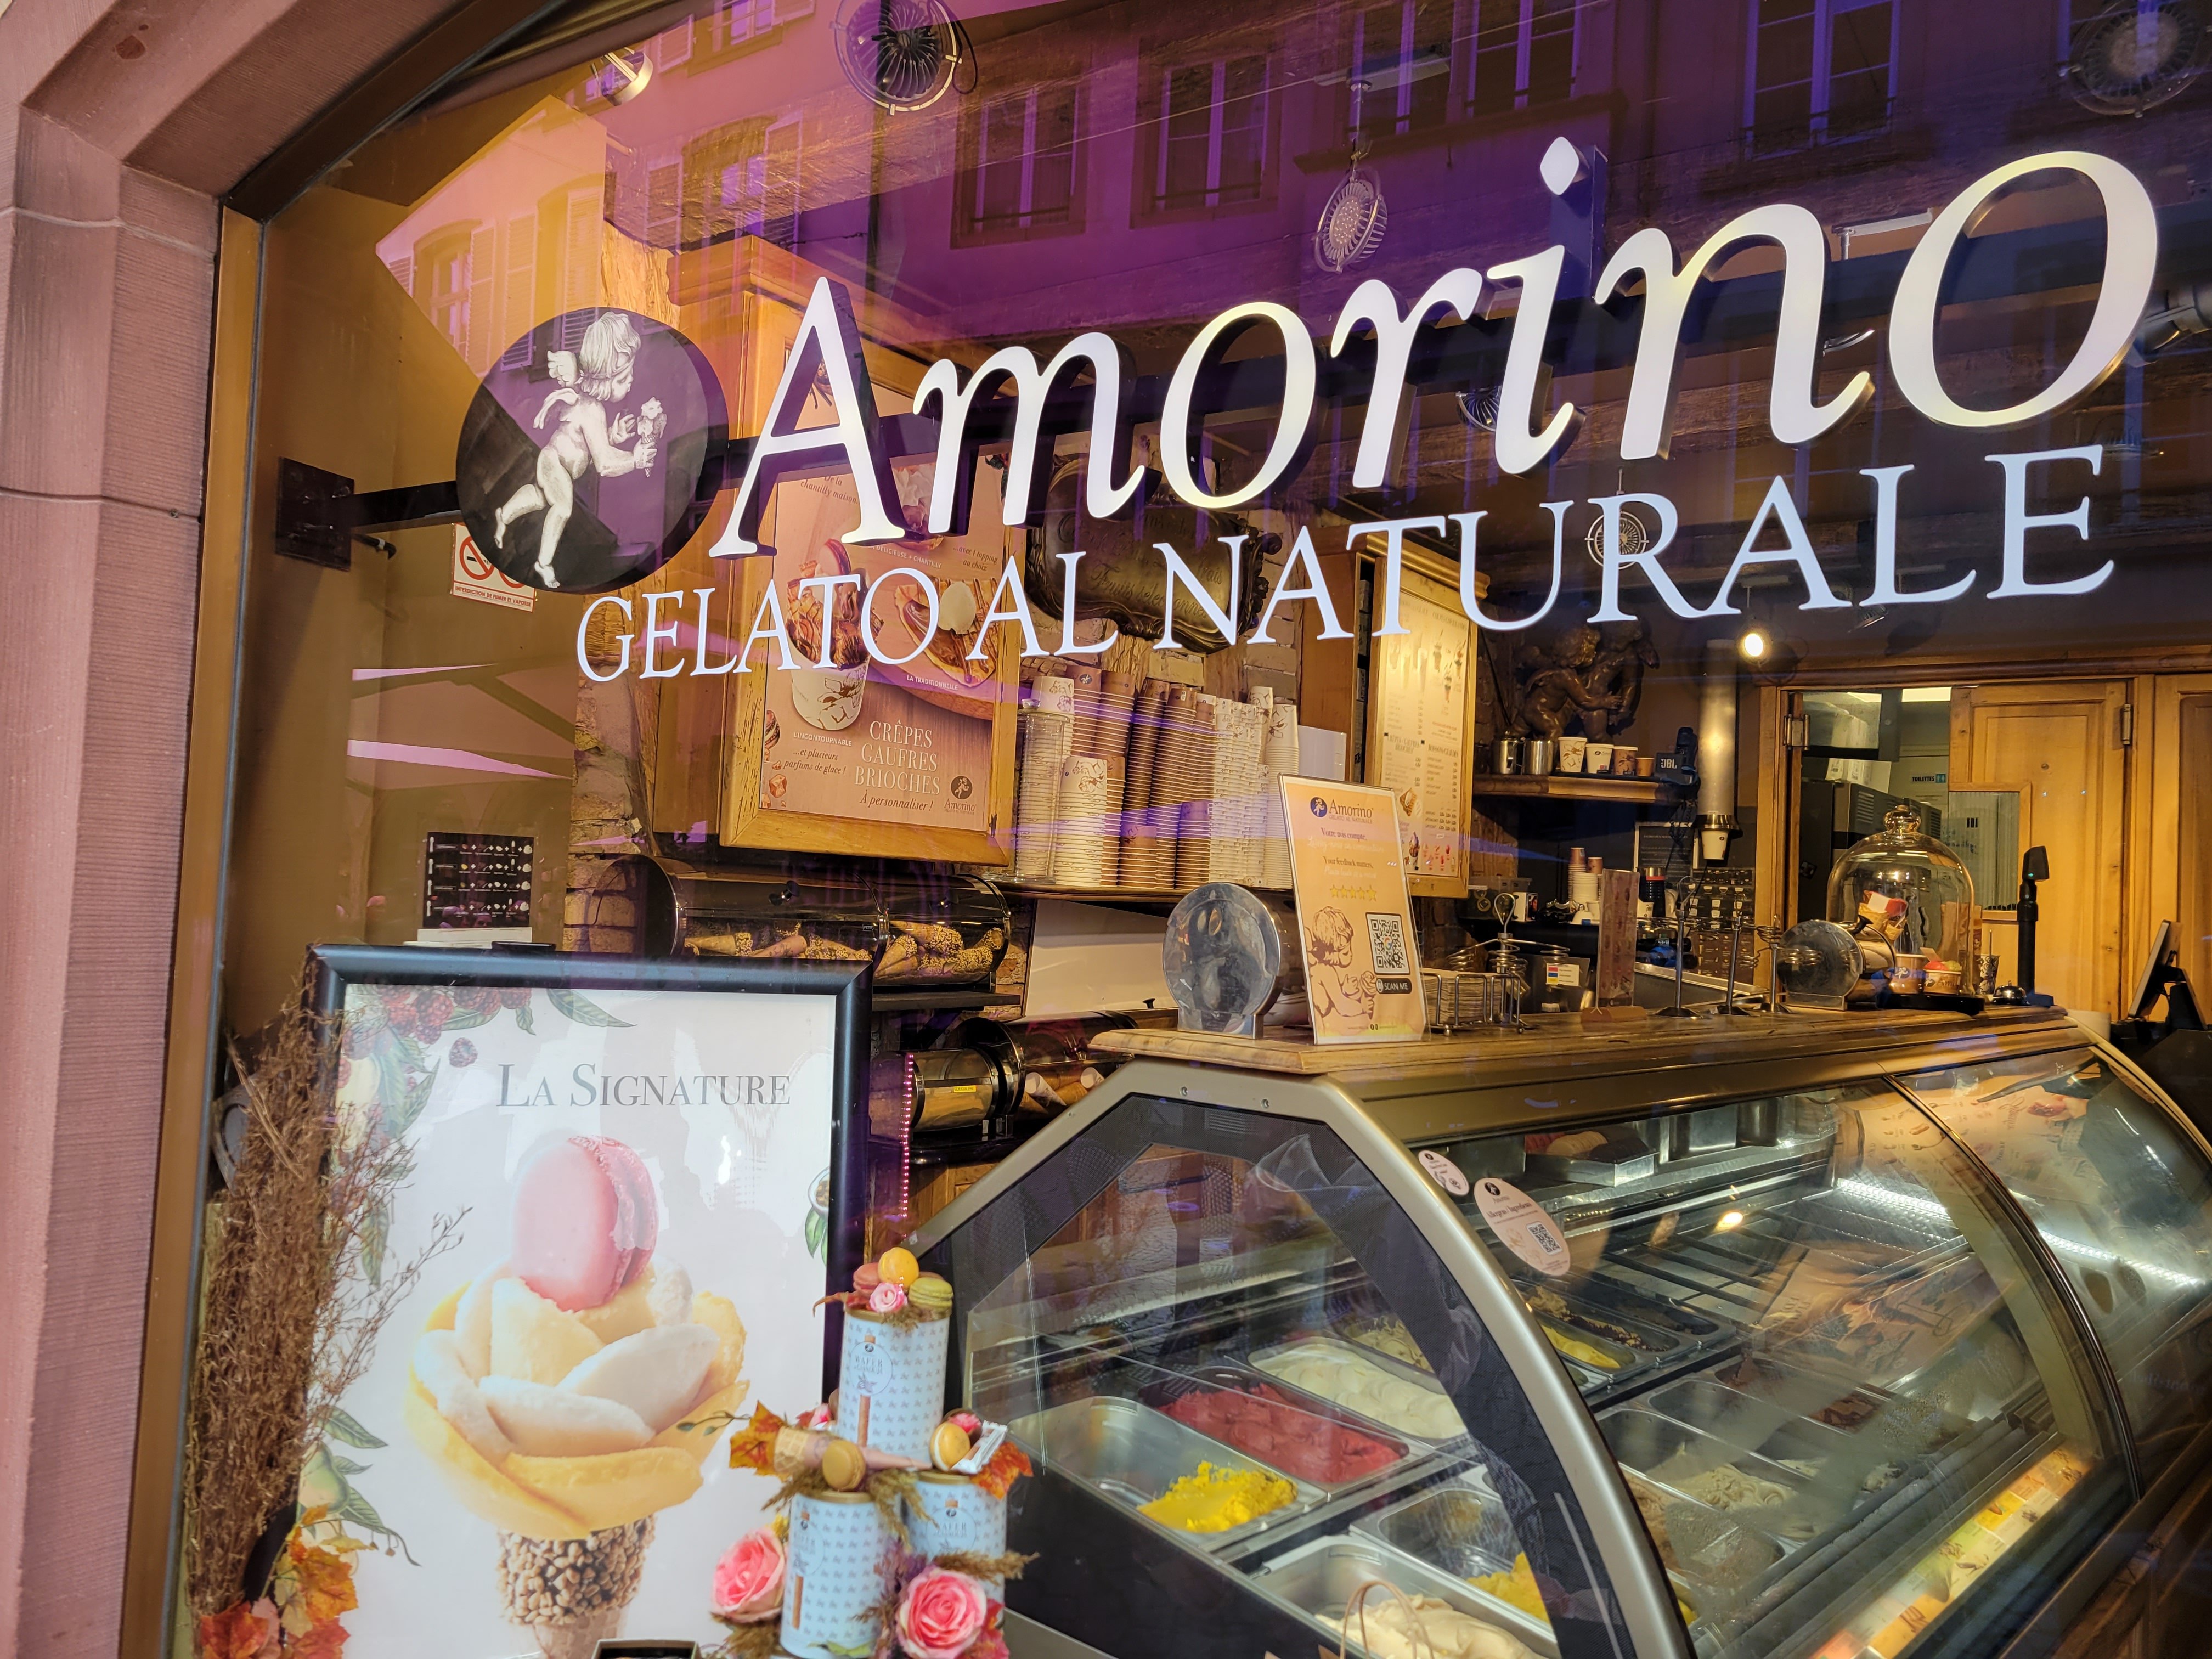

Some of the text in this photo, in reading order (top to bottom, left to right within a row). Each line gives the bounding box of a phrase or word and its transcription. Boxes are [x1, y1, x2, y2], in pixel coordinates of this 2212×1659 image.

[708, 136, 2160, 558] Amorino
[800, 479, 832, 496] chantilly
[836, 478, 843, 487] la
[576, 443, 2115, 682] GELATO AL NATURALE
[913, 555, 943, 569] CHANTILLY
[977, 551, 998, 565] topping
[971, 561, 988, 572] choix
[455, 586, 486, 597] INTERDICTION
[493, 594, 507, 602] FUMER
[512, 599, 531, 607] VAPOTER
[906, 674, 959, 691] LA TRADITIONNELLE
[869, 719, 933, 749] CRÊPES
[807, 748, 839, 761] plusieurs
[861, 743, 938, 773] GAUFRES
[783, 759, 813, 772] parfums
[814, 763, 822, 772] de
[823, 764, 842, 775] glace
[1661, 758, 1678, 769] JBL
[854, 765, 941, 796] BRIOCHES
[868, 795, 928, 811] personnaliser
[944, 798, 975, 812] Amorino
[1329, 798, 1373, 819] Amorino
[1321, 827, 1337, 838] Votre
[1337, 830, 1347, 838] avis
[1323, 855, 1336, 865] Your
[1336, 857, 1356, 867] feedback
[1384, 982, 1408, 991] SCAN ME
